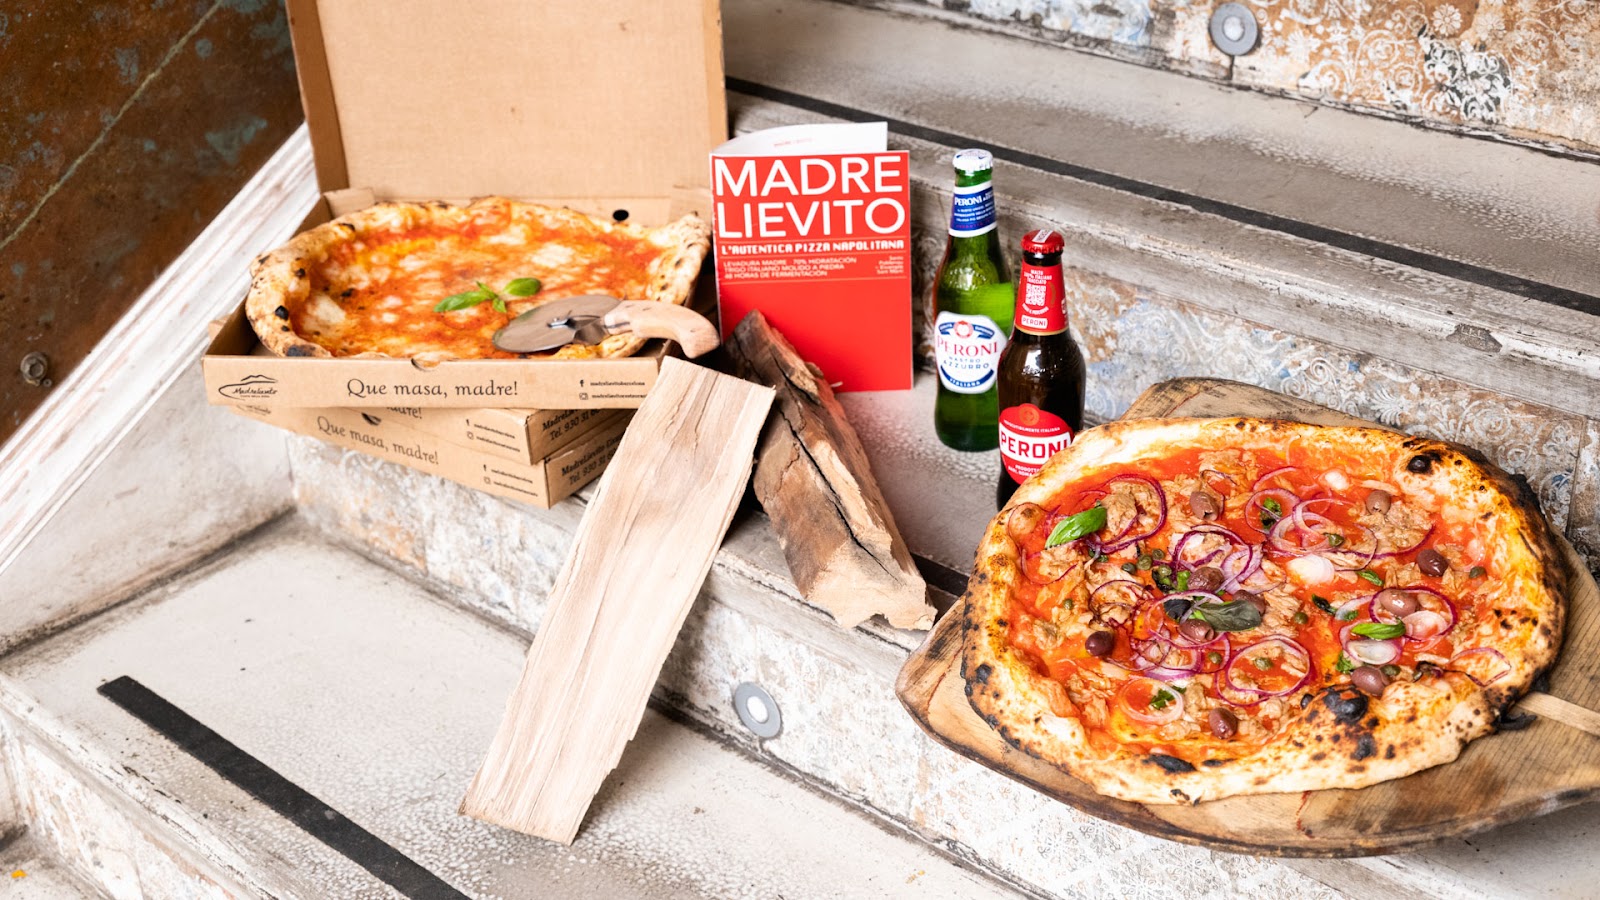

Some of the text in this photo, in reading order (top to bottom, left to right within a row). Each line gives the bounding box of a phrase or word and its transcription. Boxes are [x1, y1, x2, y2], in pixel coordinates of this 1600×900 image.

[714, 155, 903, 197] MADRE
[954, 195, 983, 206] PERONI
[717, 197, 905, 238] LIEVITO
[721, 239, 905, 255] L'AUTENTICA PIZZA NAPOLITANA
[1022, 317, 1046, 327] PERONI
[937, 335, 998, 357] PERONI
[943, 360, 990, 369] AZZURRO
[347, 378, 518, 398] Que masa, madre!
[949, 378, 981, 388] ITALIANA
[564, 416, 579, 432] 930
[317, 416, 439, 465] Que masa, madre!
[1001, 430, 1068, 459] PERONI
